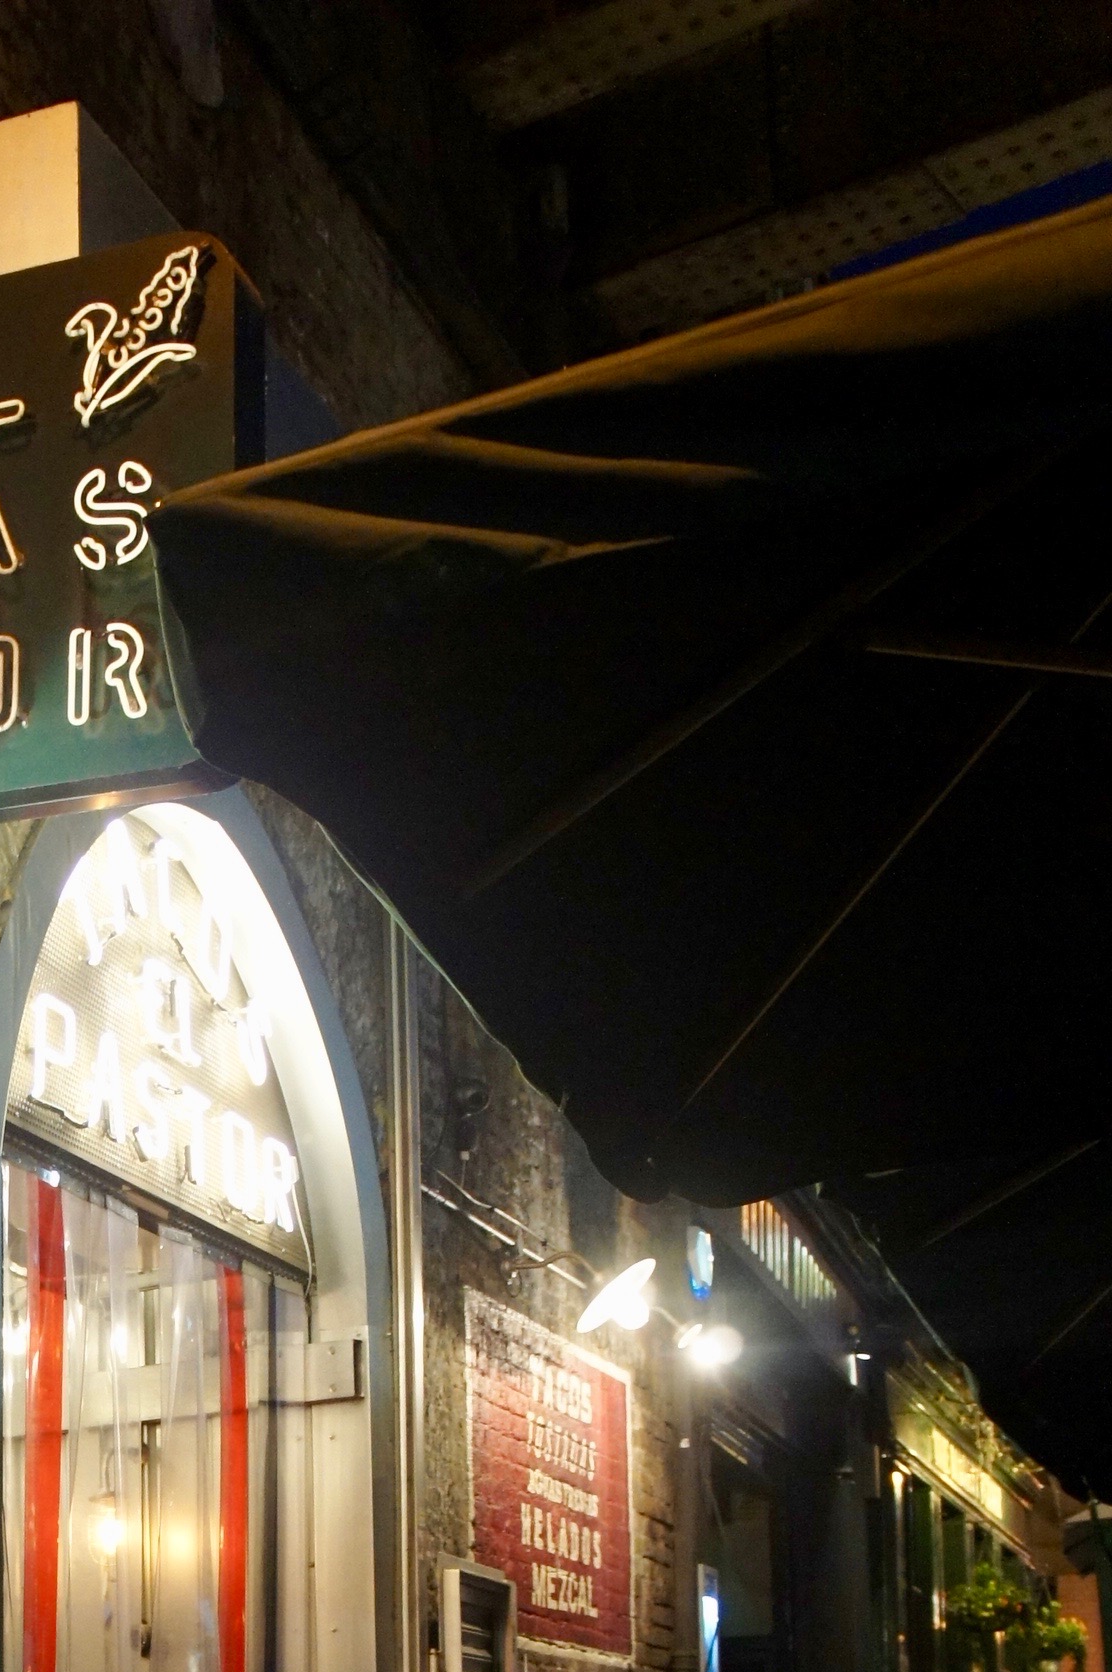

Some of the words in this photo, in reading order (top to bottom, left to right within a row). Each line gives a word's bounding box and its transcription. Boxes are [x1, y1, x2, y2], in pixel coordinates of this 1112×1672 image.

[28, 992, 297, 1234] PASTOR
[529, 1353, 593, 1425] TACOS
[520, 1502, 603, 1570] HELADOS
[531, 1562, 599, 1618] MEZCAL
